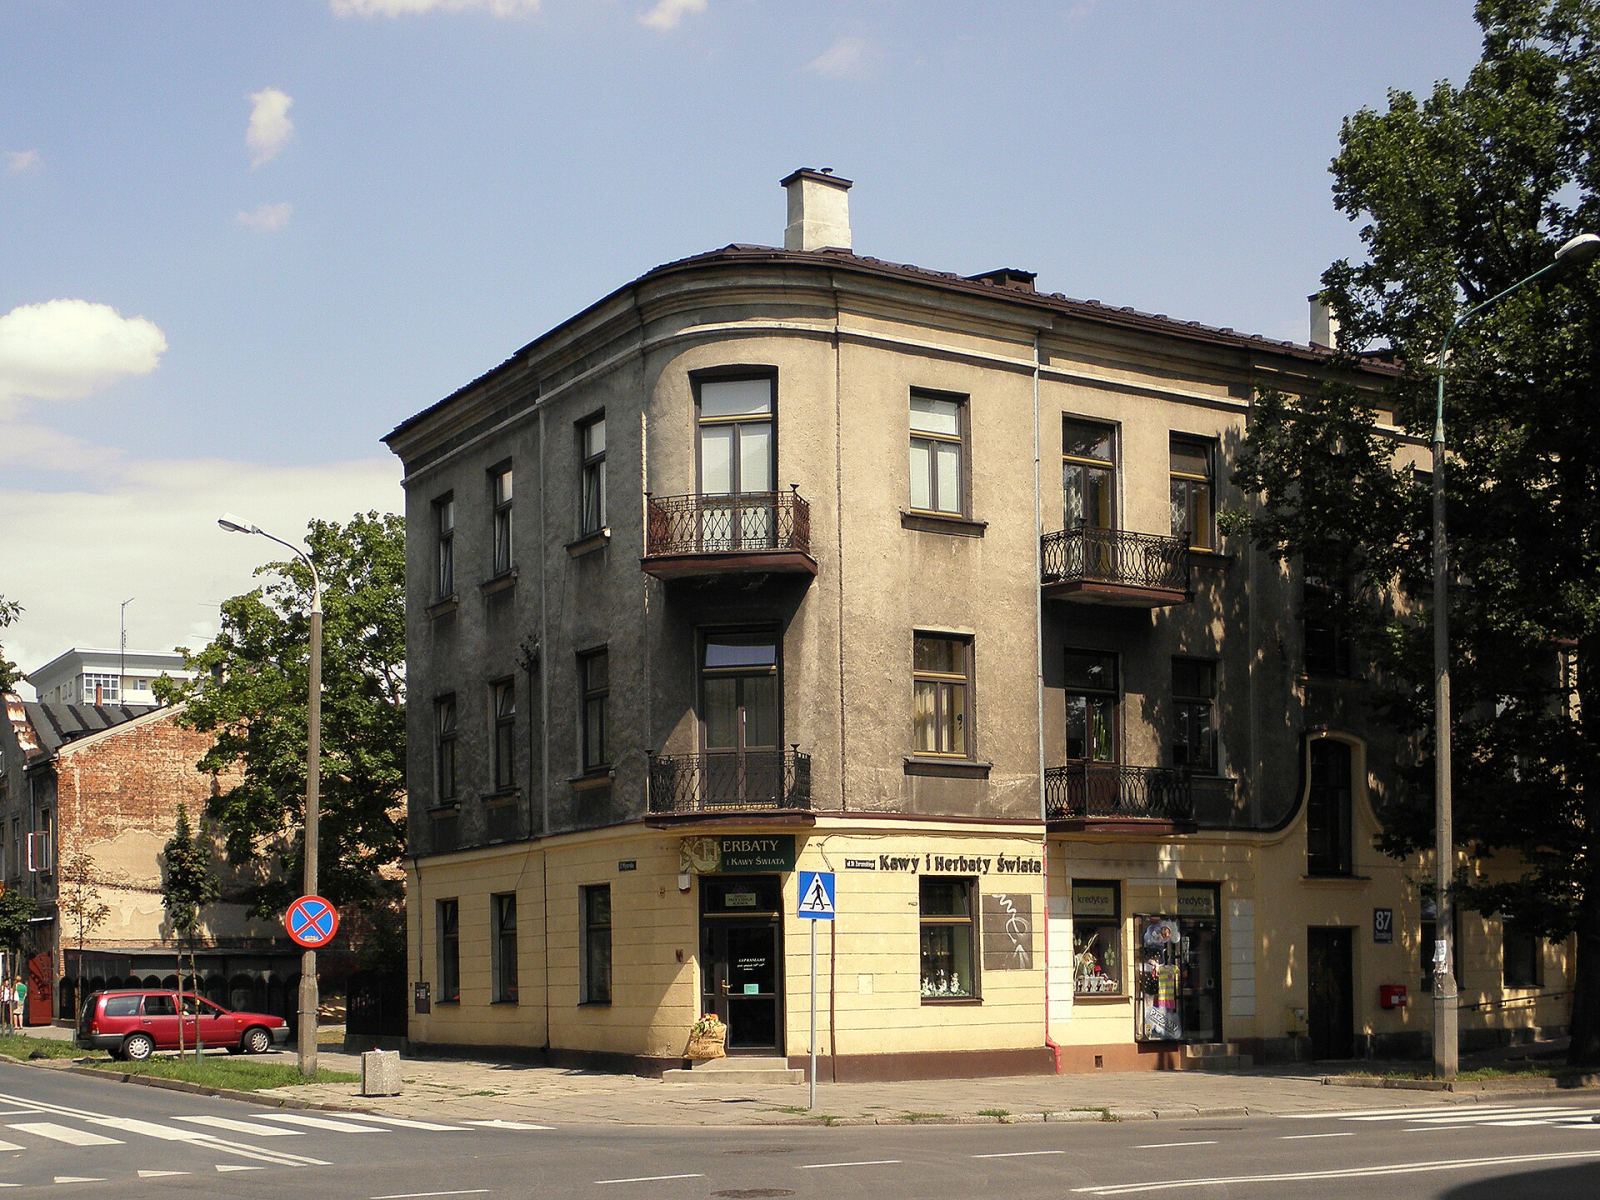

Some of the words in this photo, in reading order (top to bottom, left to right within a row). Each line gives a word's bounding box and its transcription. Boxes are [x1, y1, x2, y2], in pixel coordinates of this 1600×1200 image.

[879, 855, 920, 874] Kawy
[925, 852, 931, 872] i
[935, 856, 991, 875] Herbaty
[997, 852, 1041, 873] Świata
[1375, 911, 1391, 930] 87
